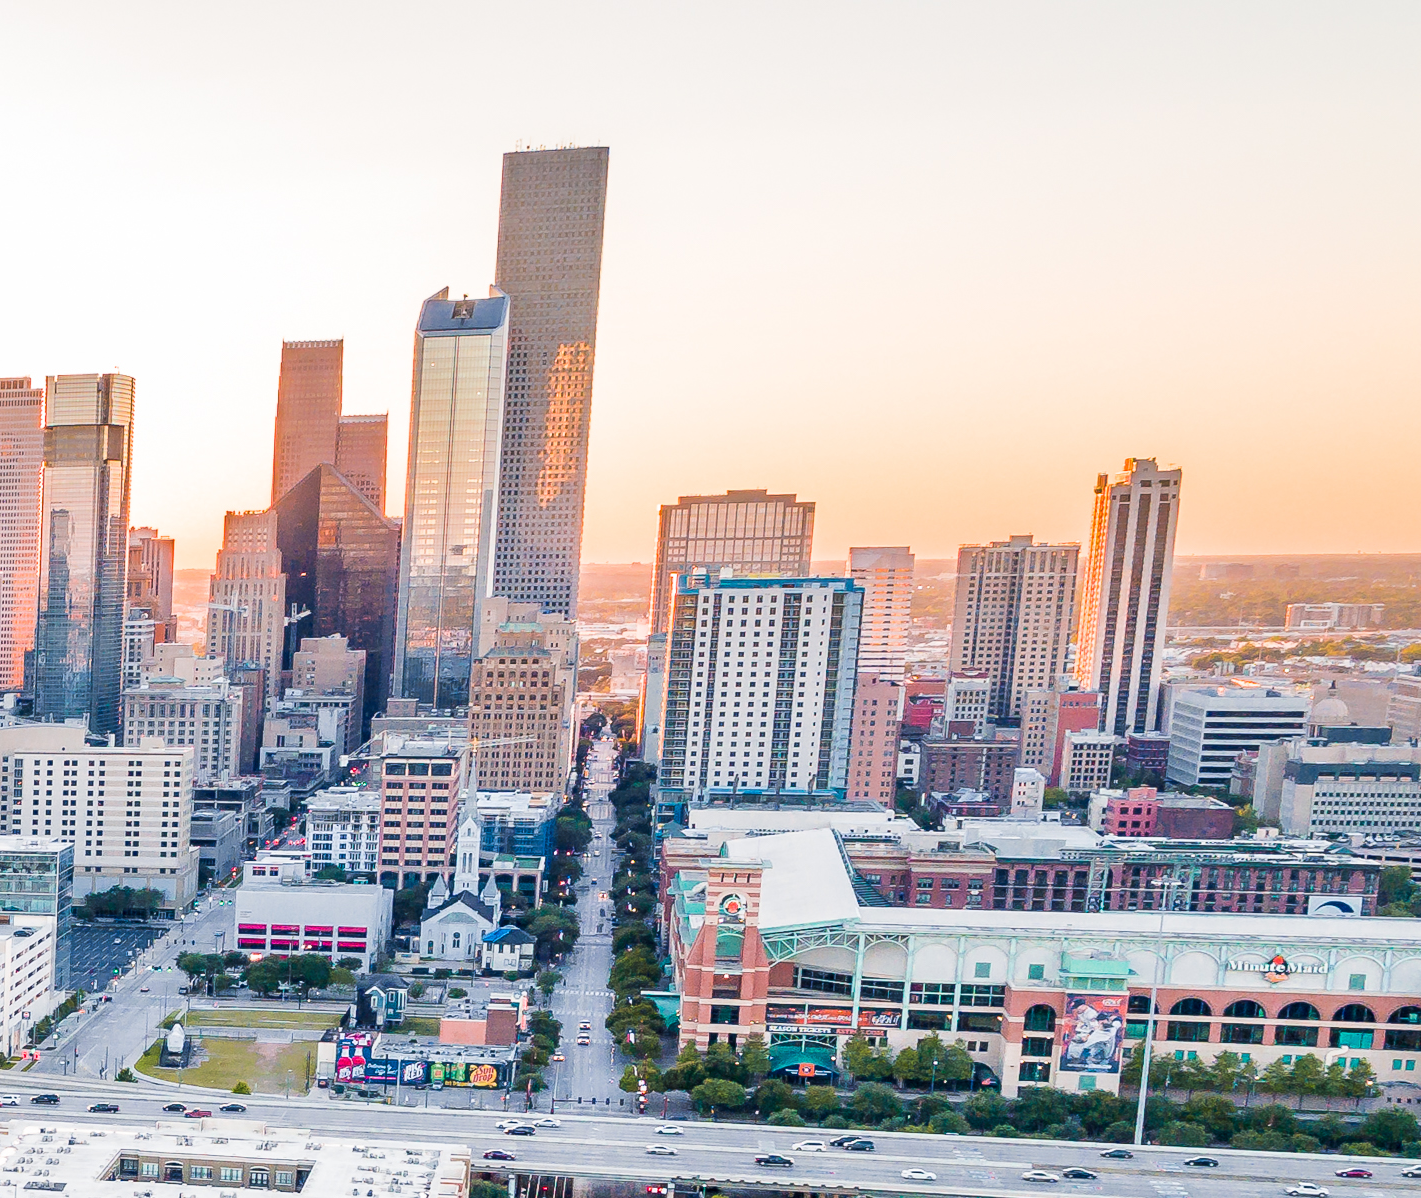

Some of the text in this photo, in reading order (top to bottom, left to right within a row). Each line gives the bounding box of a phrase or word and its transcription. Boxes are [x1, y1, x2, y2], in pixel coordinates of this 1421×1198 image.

[1227, 959, 1329, 974] Minute Maid
[769, 1025, 798, 1033] SEASON
[799, 1026, 832, 1034] TICKETS
[405, 1062, 422, 1073] BIG
[478, 1065, 494, 1075] Sun
[404, 1069, 424, 1081] RED
[472, 1073, 494, 1083] Drop
